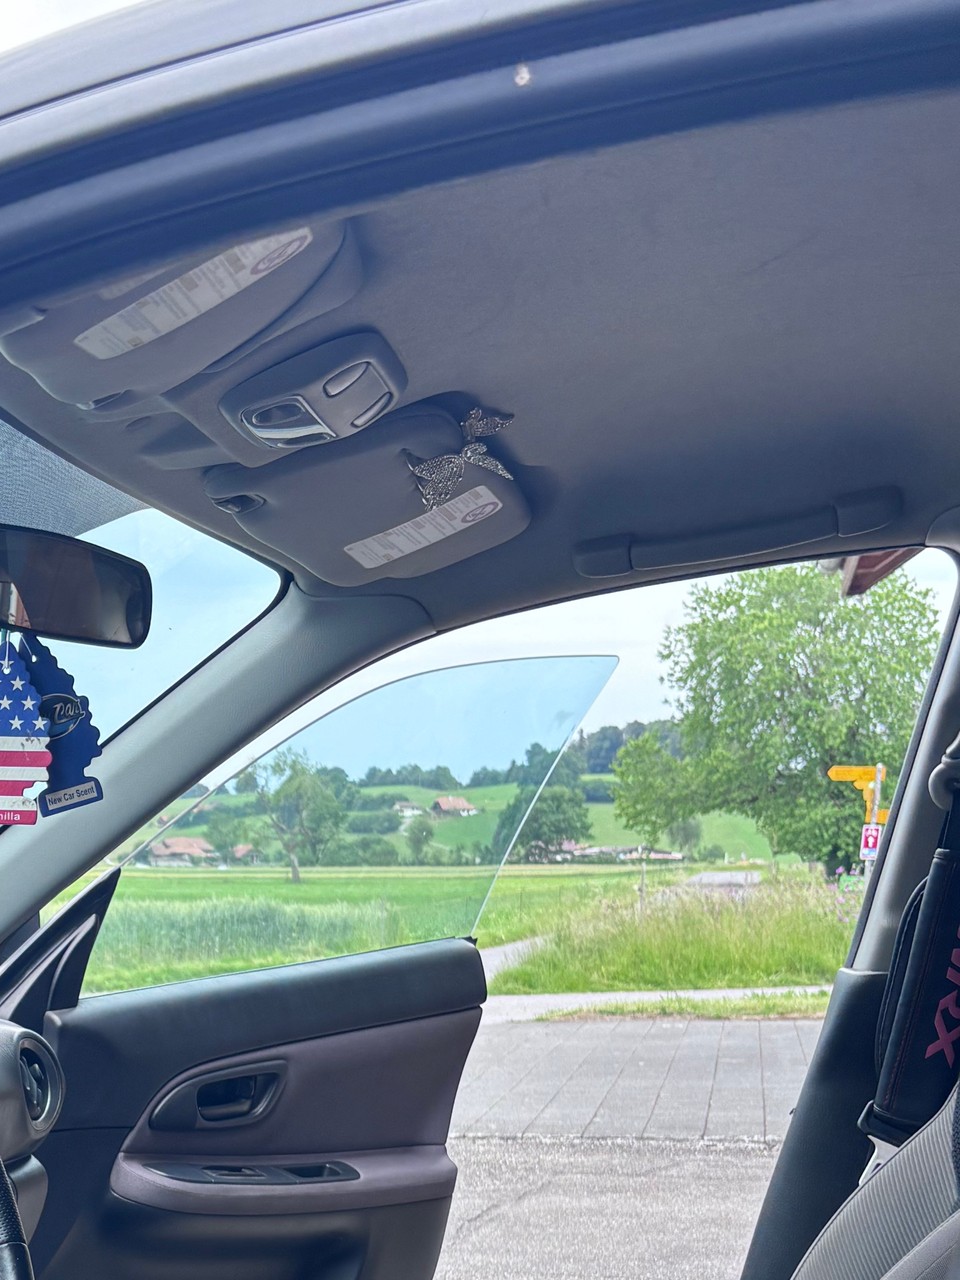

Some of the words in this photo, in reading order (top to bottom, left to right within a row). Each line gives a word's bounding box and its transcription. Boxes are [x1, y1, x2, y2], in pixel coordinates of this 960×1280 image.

[48, 796, 63, 806] New
[63, 792, 75, 801] Car
[75, 786, 95, 798] Scent
